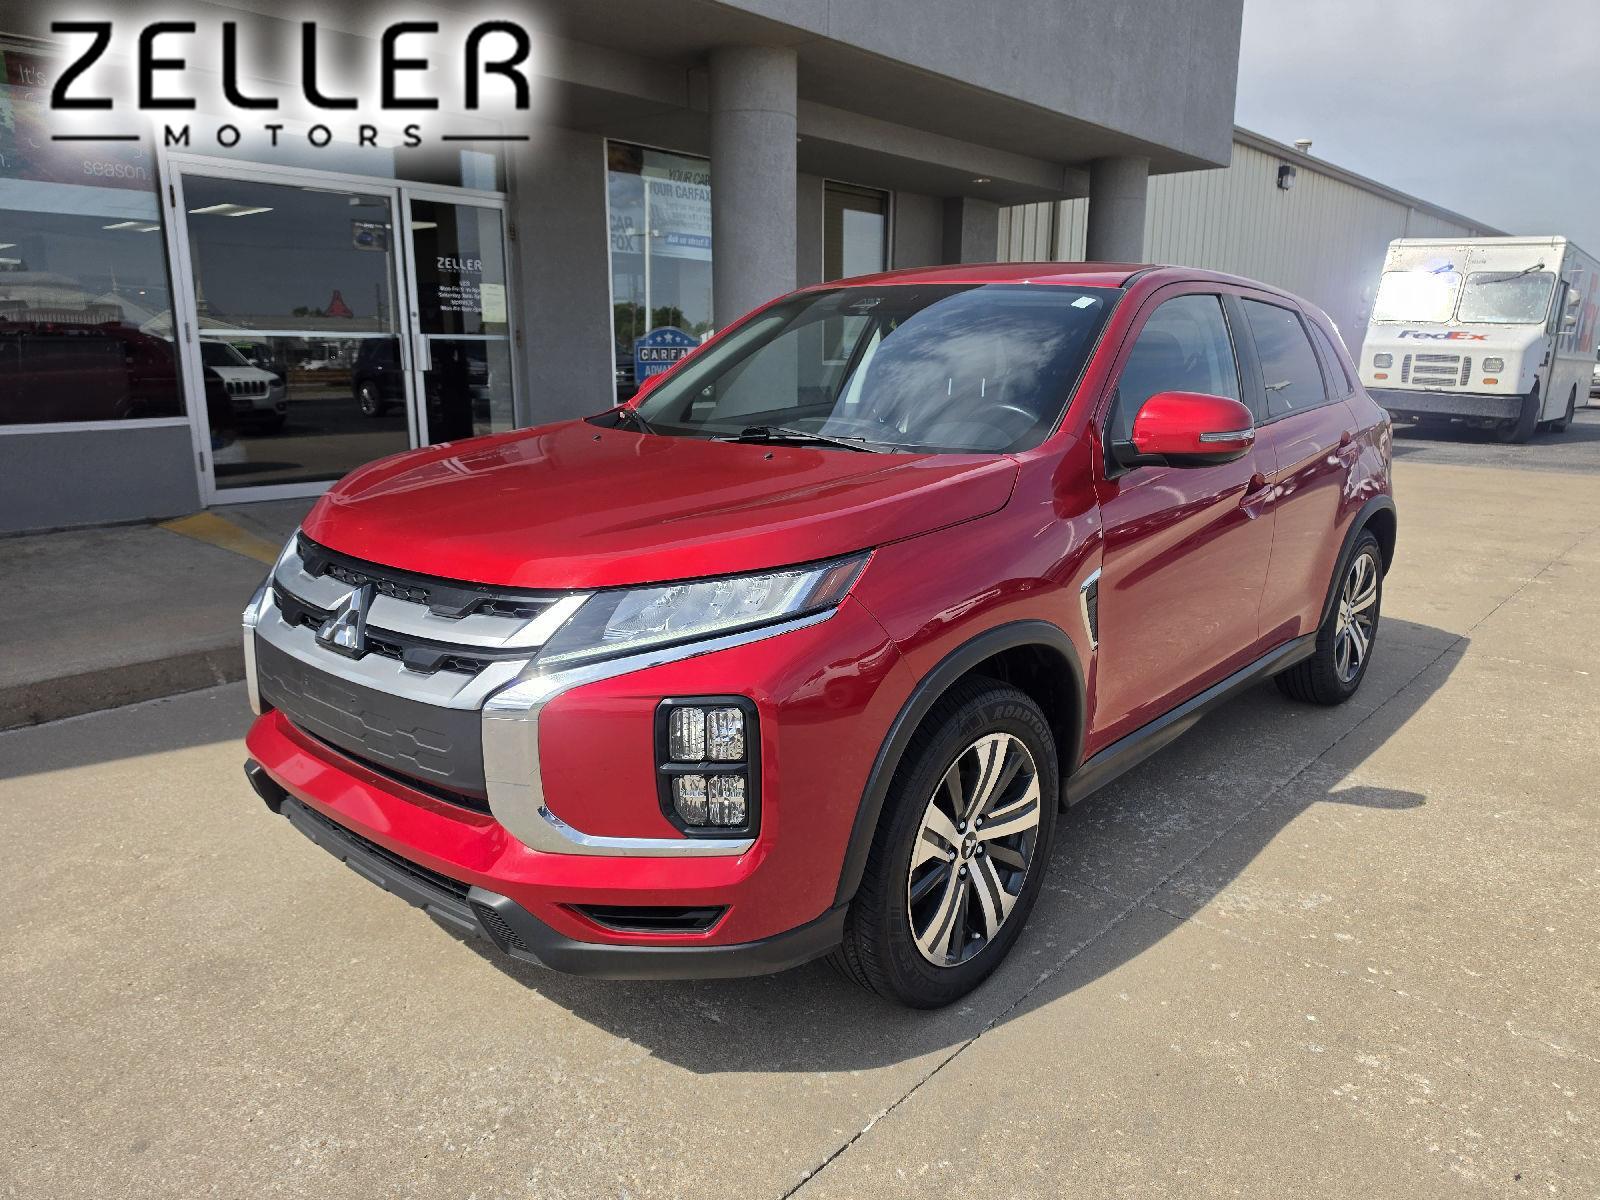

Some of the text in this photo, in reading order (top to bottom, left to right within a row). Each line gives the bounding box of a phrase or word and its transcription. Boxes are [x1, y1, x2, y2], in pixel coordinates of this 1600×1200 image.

[18, 63, 48, 86] It's
[82, 160, 152, 182] season.
[437, 256, 482, 271] ZELLER
[1397, 330, 1490, 340] FedEx
[641, 349, 688, 360] CARFA
